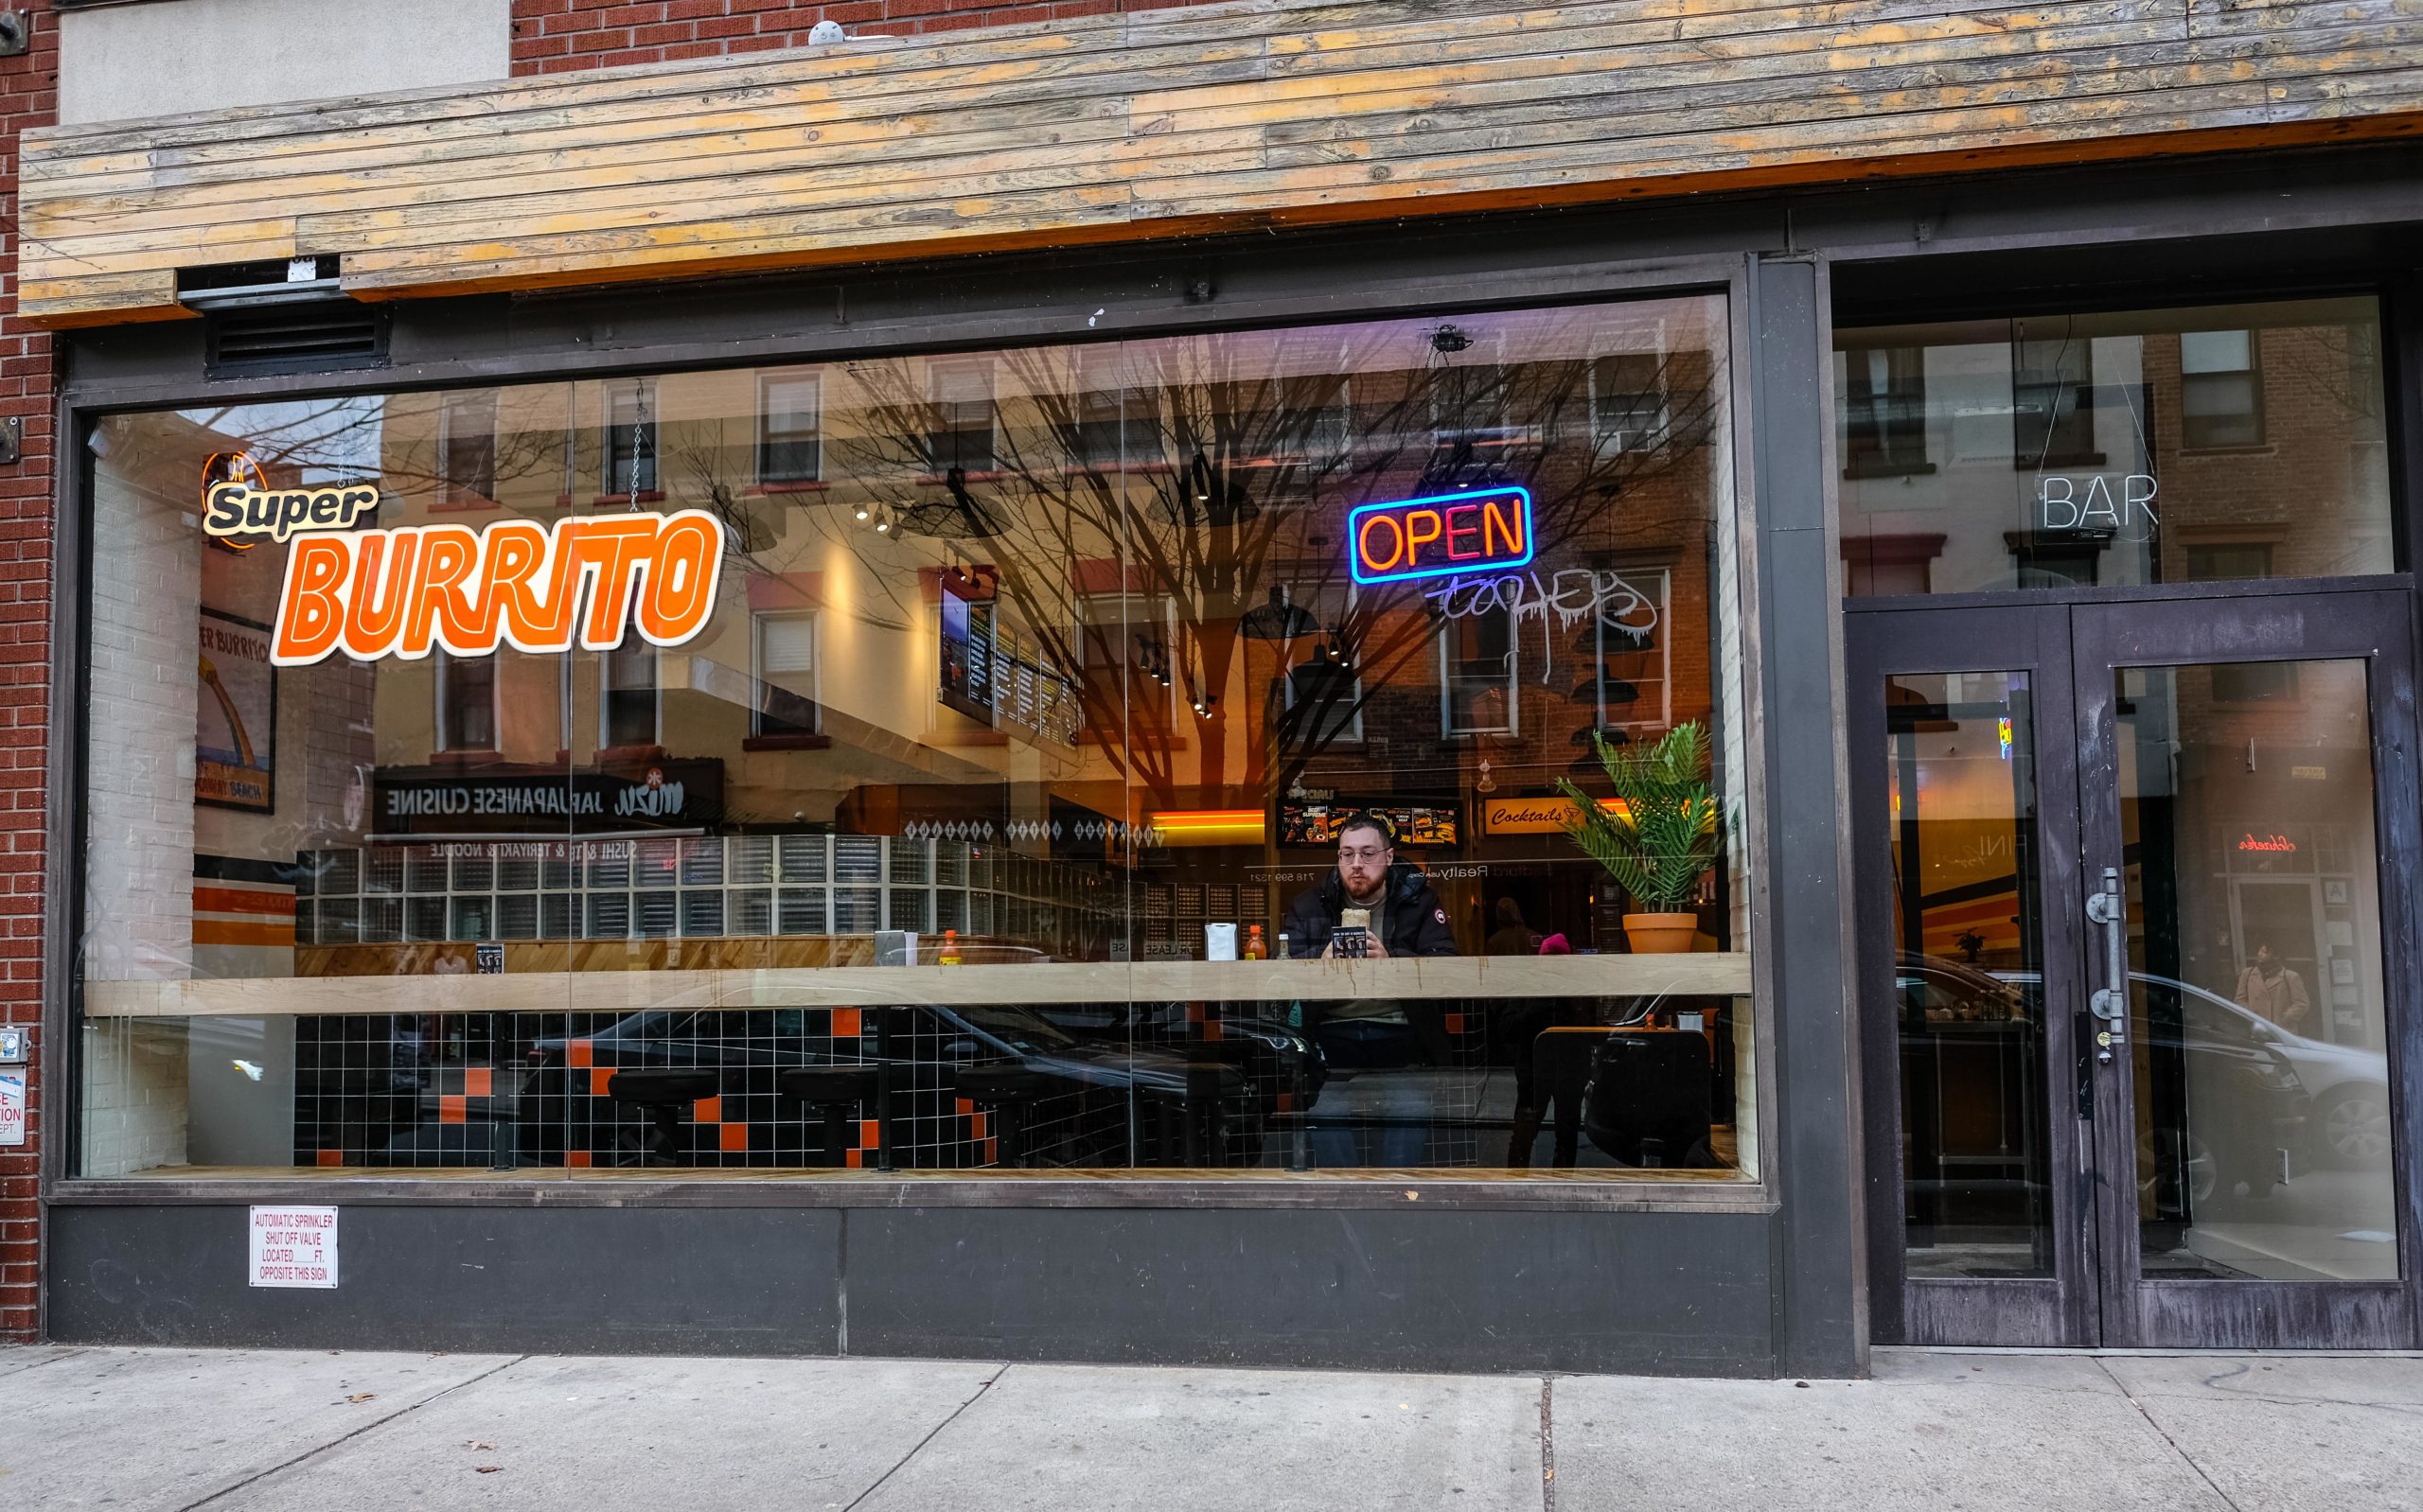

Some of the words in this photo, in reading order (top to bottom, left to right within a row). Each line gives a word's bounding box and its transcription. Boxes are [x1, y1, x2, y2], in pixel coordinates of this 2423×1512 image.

[209, 483, 376, 536] Super
[2043, 474, 2159, 529] BAR
[1359, 498, 1525, 571] OPEN
[277, 515, 719, 659] BURRITO
[216, 628, 269, 663] BURRITO
[230, 781, 263, 800] BEACH
[1287, 789, 1335, 800] SECIALS
[1492, 807, 1564, 826] Cocktails
[255, 1214, 294, 1227] AUTOMATIC
[294, 1215, 333, 1228] SPRINKLER
[265, 1231, 284, 1245] SHUT
[284, 1232, 298, 1245] OFF
[299, 1232, 322, 1246] VALVE
[262, 1249, 293, 1262] LOCATED
[314, 1250, 325, 1263] FT.
[259, 1266, 293, 1280] OPPOSITE
[294, 1267, 310, 1280] THIS
[310, 1267, 327, 1281] SIGN
